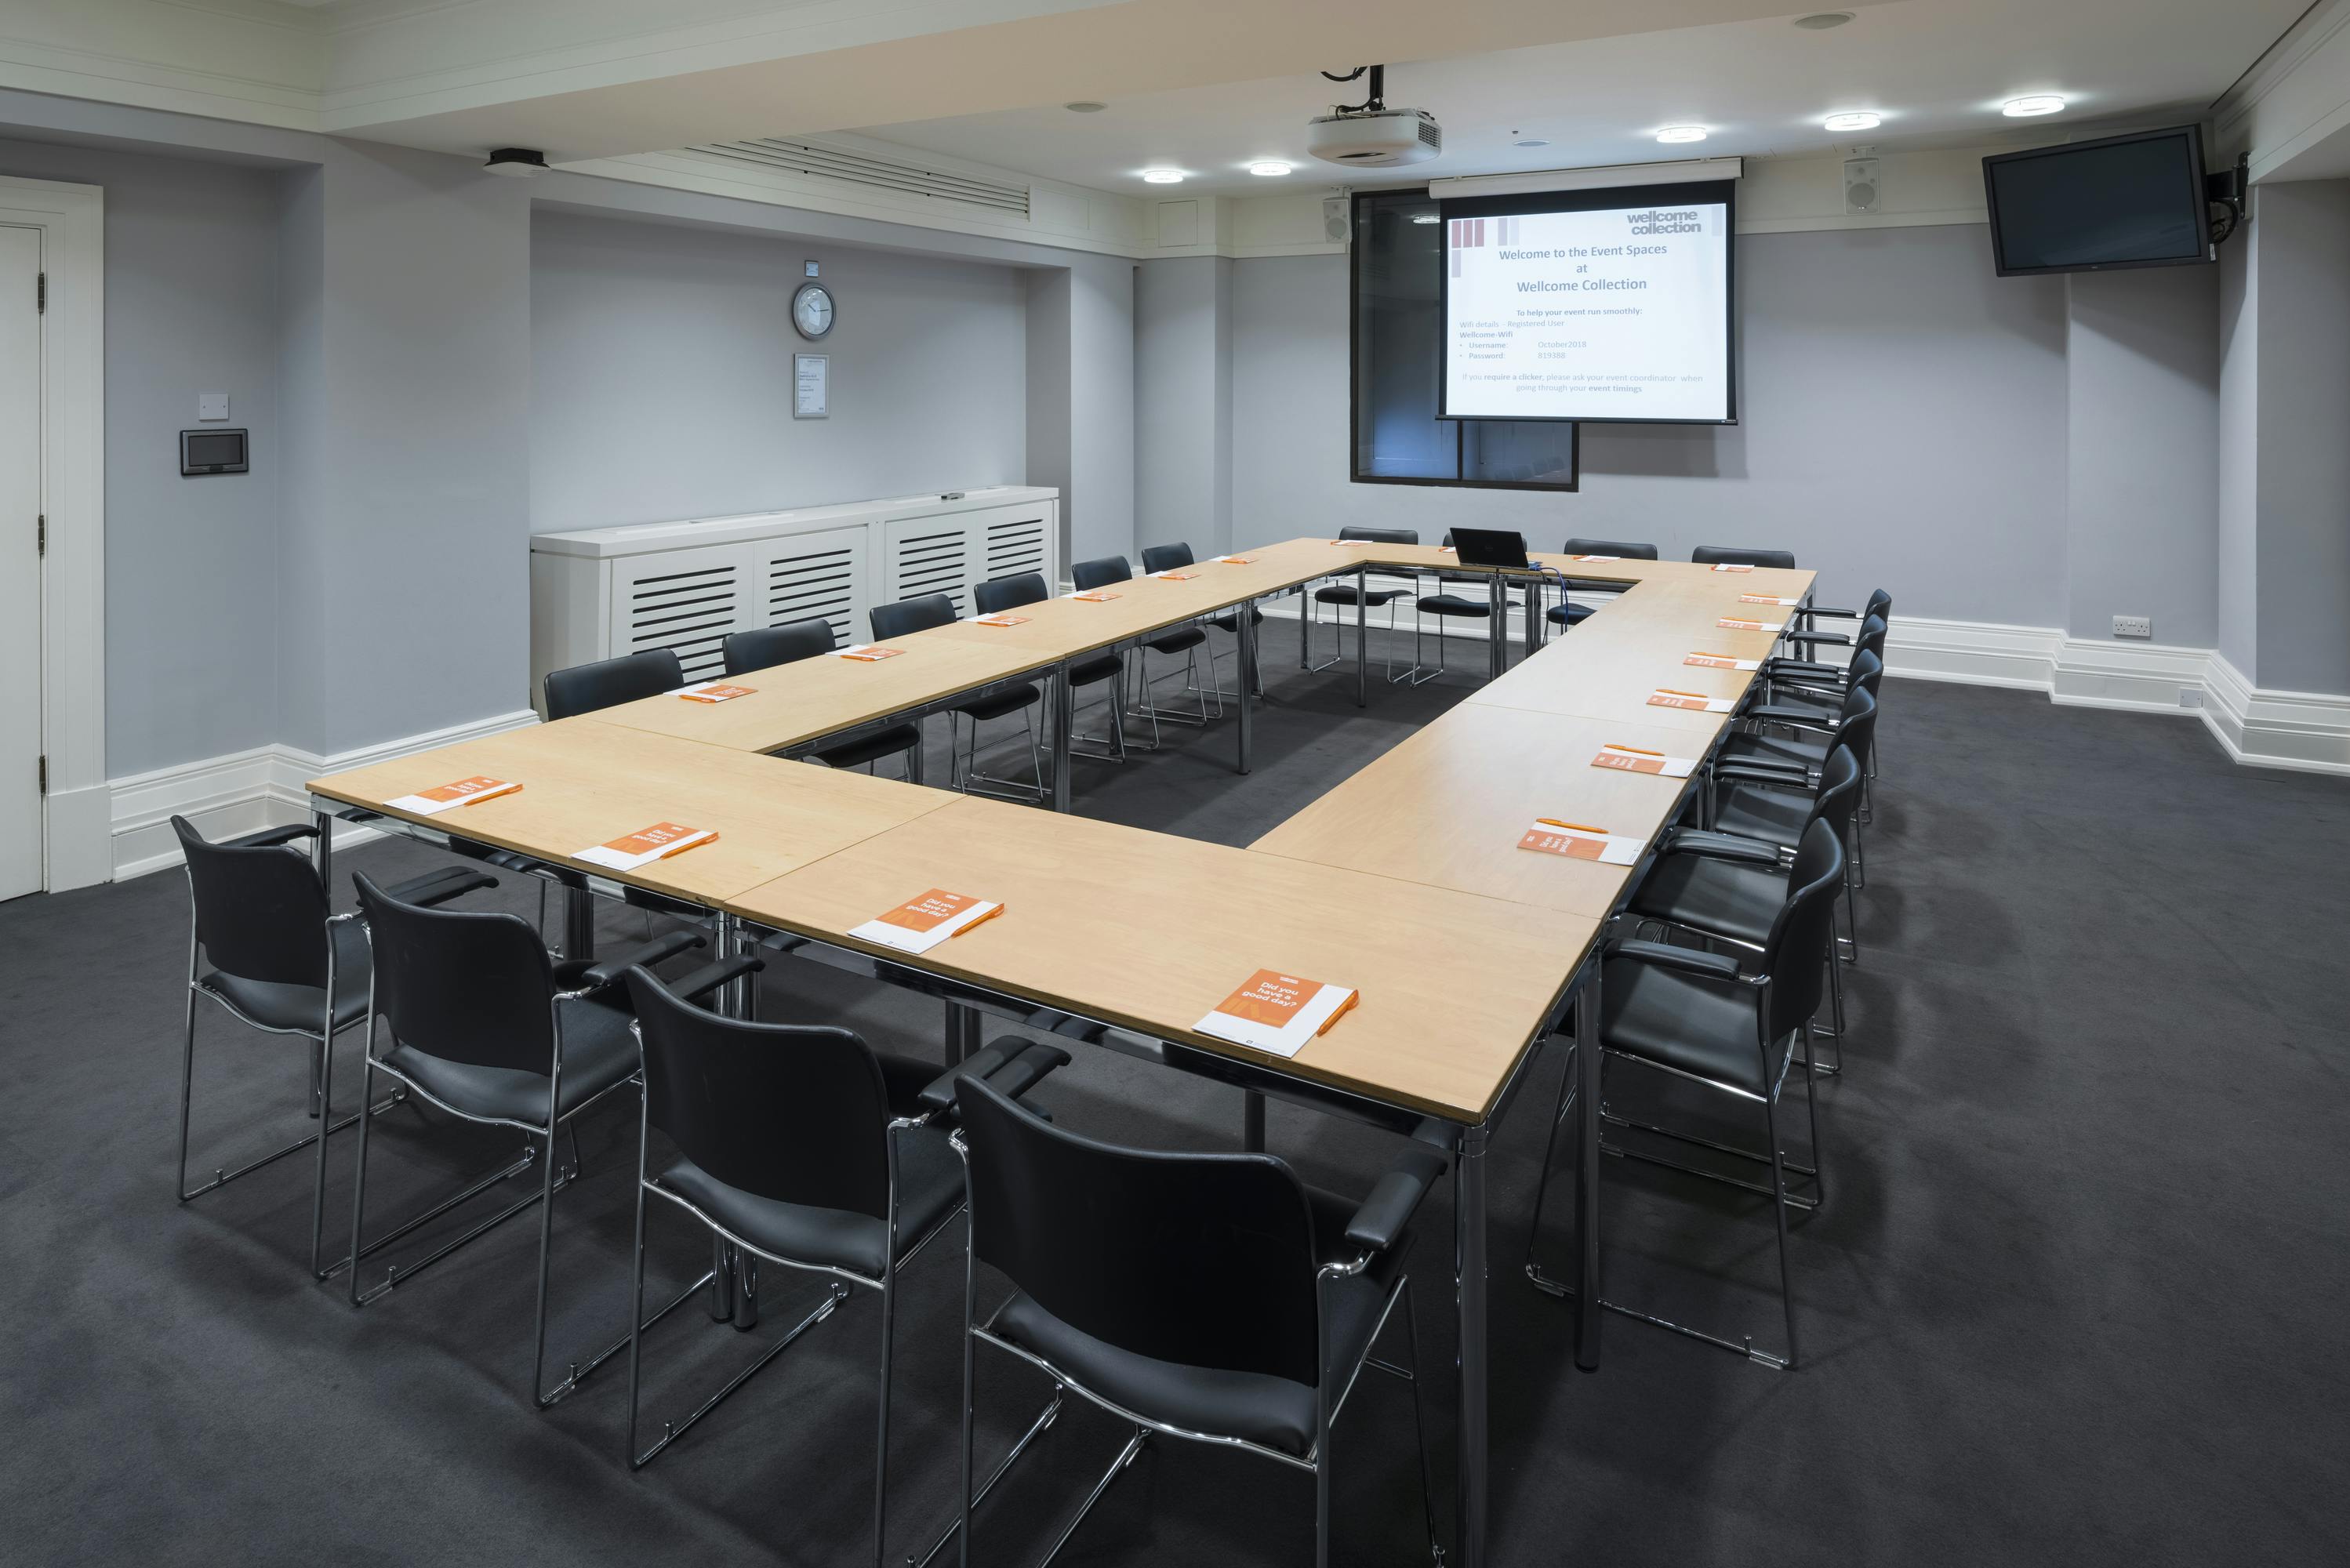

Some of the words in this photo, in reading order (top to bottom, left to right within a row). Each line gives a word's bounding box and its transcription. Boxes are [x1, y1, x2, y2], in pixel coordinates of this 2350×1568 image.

[1627, 210, 1698, 223] wellcome
[1631, 222, 1702, 235] collection
[1499, 250, 1550, 260] Welcome
[1553, 249, 1565, 259] to
[1568, 247, 1588, 258] the
[1591, 245, 1623, 256] Event
[1626, 245, 1668, 257] Spaces
[1576, 264, 1588, 274] at
[1516, 281, 1578, 292] Wellcome
[1582, 278, 1647, 291] Collection
[1527, 309, 1543, 318] help
[1603, 307, 1643, 317] smoothly:
[1507, 320, 1545, 328] Registered
[1538, 340, 1587, 349] October2018
[1484, 374, 1510, 383] require
[1546, 374, 1570, 383] please
[1629, 373, 1676, 383] coordinator
[1680, 374, 1704, 383] when
[1516, 384, 1536, 393] going
[1538, 384, 1567, 393] through
[1613, 384, 1643, 394] timings
[1257, 987, 1283, 998] have
[1260, 982, 1280, 991] Did
[1278, 987, 1299, 996] you
[1241, 991, 1270, 1001] good
[1270, 998, 1298, 1007] day?
